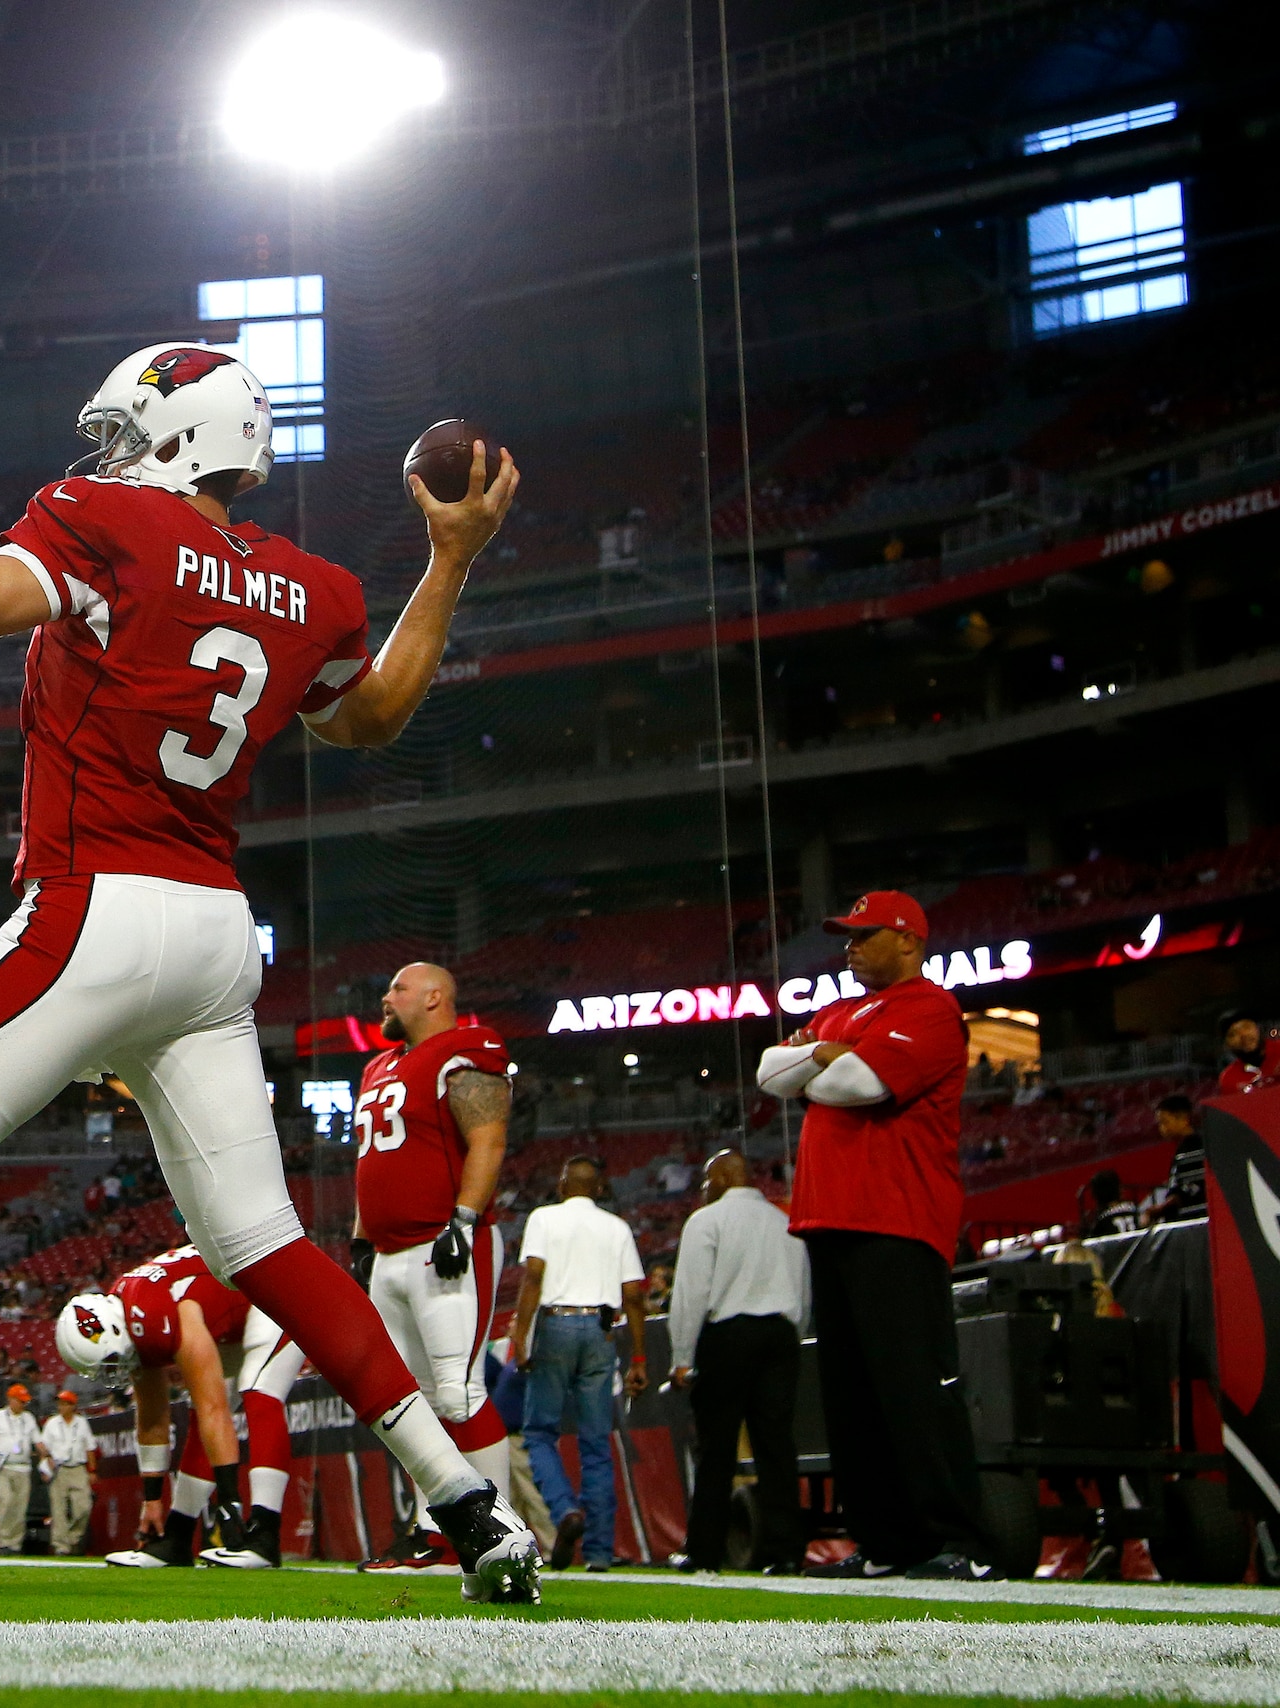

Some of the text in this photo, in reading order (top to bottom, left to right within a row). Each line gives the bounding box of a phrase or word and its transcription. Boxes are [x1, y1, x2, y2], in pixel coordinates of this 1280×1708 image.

[1100, 515, 1175, 557] JIMMY
[175, 543, 308, 626] PALMER
[438, 662, 481, 683] SON
[158, 626, 270, 791] 3
[545, 983, 772, 1035] ARIZONA
[354, 1081, 407, 1159] 53
